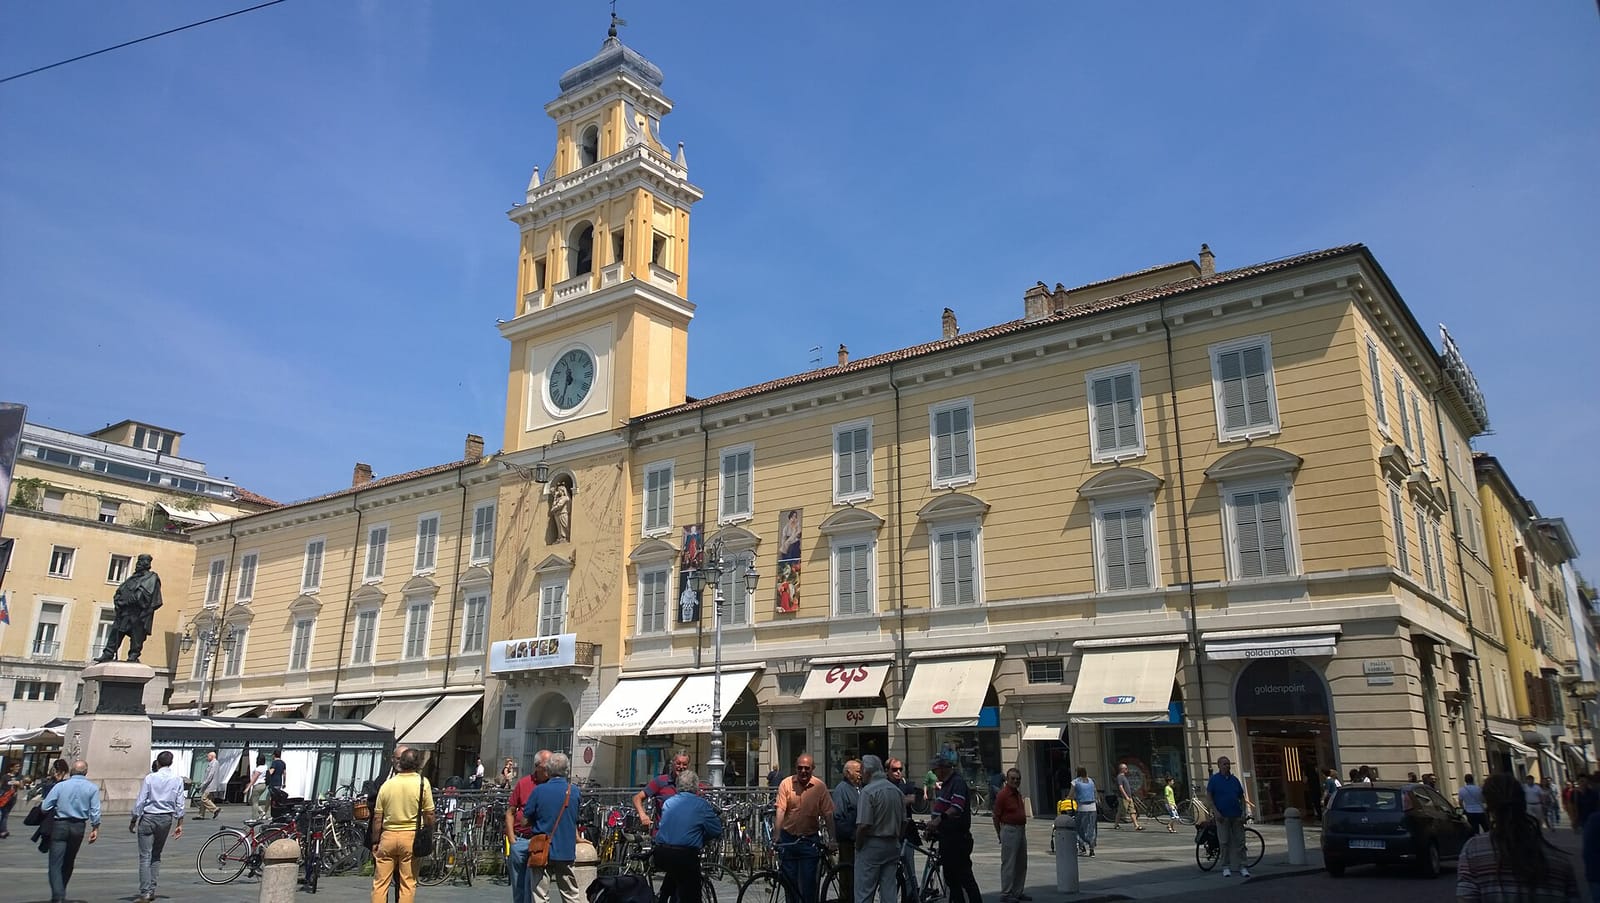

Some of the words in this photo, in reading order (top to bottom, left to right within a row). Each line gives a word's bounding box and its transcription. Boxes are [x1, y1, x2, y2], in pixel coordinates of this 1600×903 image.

[1245, 648, 1296, 659] goldenpoint
[826, 664, 868, 693] eys
[1254, 684, 1306, 695] goldenpoint
[846, 710, 865, 726] eys
